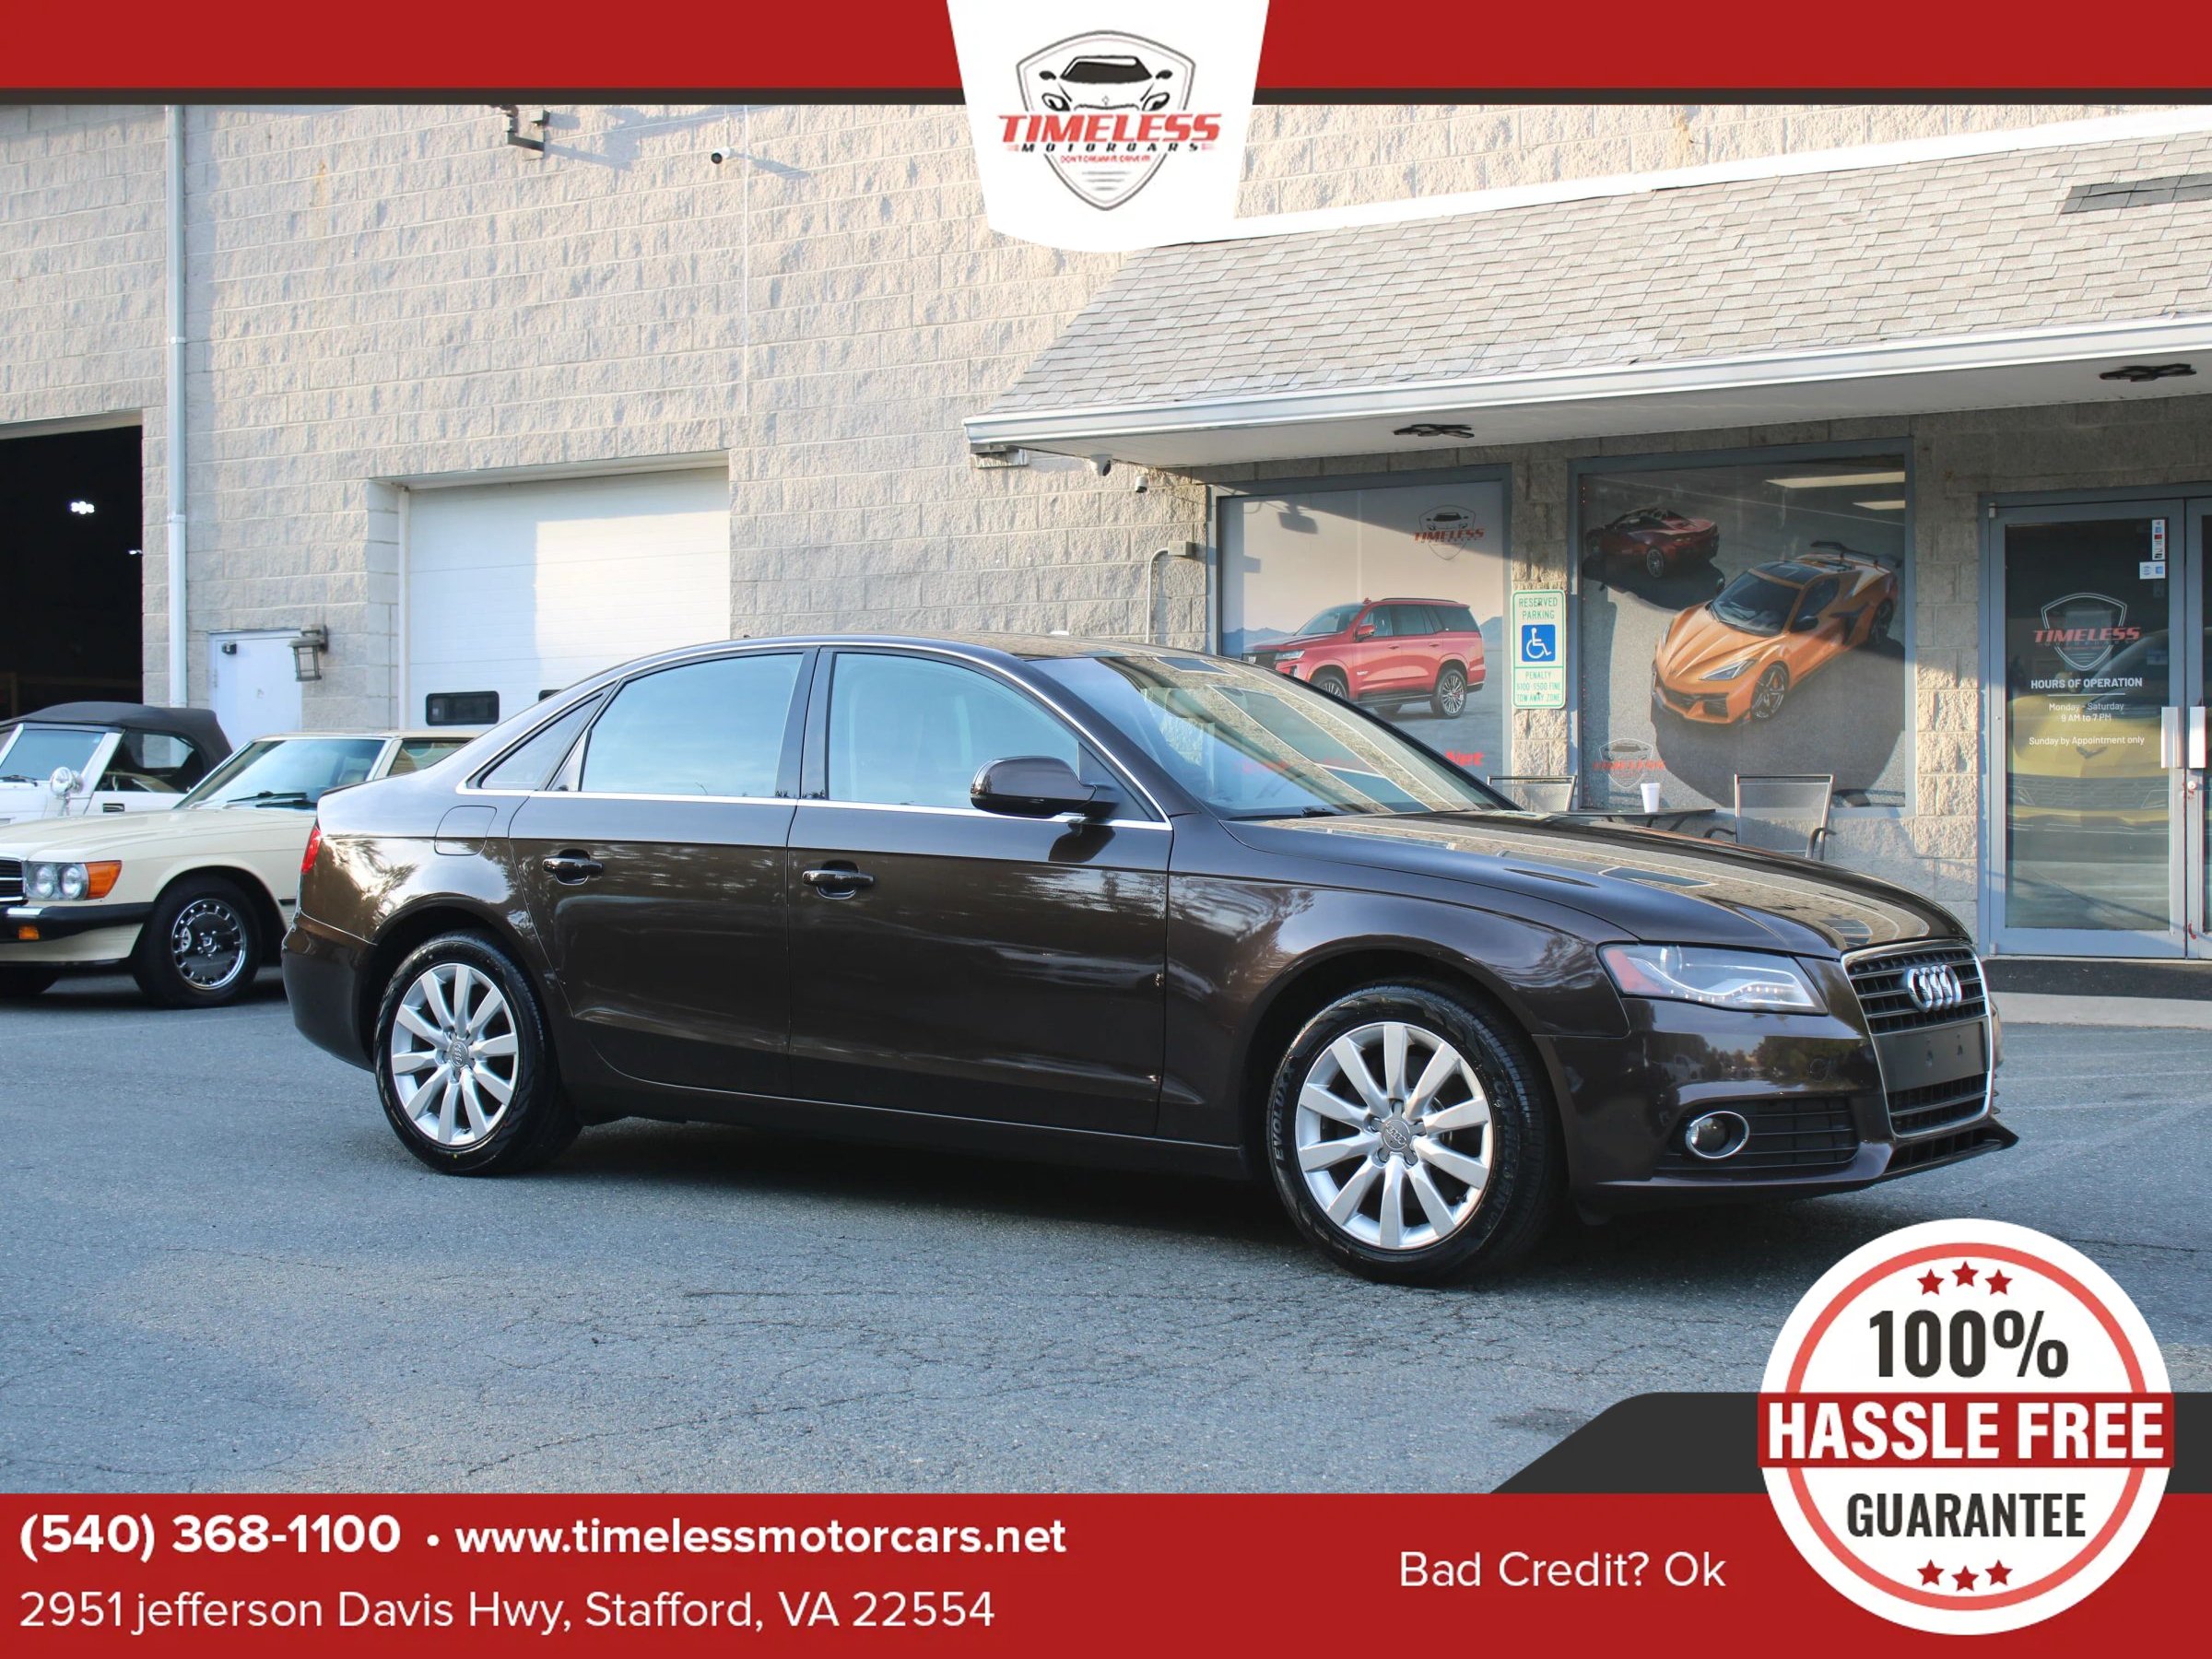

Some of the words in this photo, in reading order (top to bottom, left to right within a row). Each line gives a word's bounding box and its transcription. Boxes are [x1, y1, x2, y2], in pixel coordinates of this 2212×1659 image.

[1413, 528, 1485, 542] TIMELESS
[1519, 597, 1558, 607] RESERVED
[1522, 610, 1555, 620] PARKING
[2031, 627, 2141, 642] TIMELESS
[2030, 679, 2065, 689] HOURS
[2067, 678, 2082, 688] OF
[2083, 677, 2143, 688] OPERATION
[2049, 702, 2080, 712] Monday
[2087, 701, 2124, 712] Saturday
[2061, 714, 2067, 723] 9
[2071, 714, 2081, 723] AM
[2093, 713, 2098, 722] 7
[2100, 712, 2112, 722] PM
[2029, 736, 2059, 747] Sunday
[2060, 736, 2070, 747] by
[2071, 736, 2125, 747] Appointment
[2127, 735, 2145, 746] only
